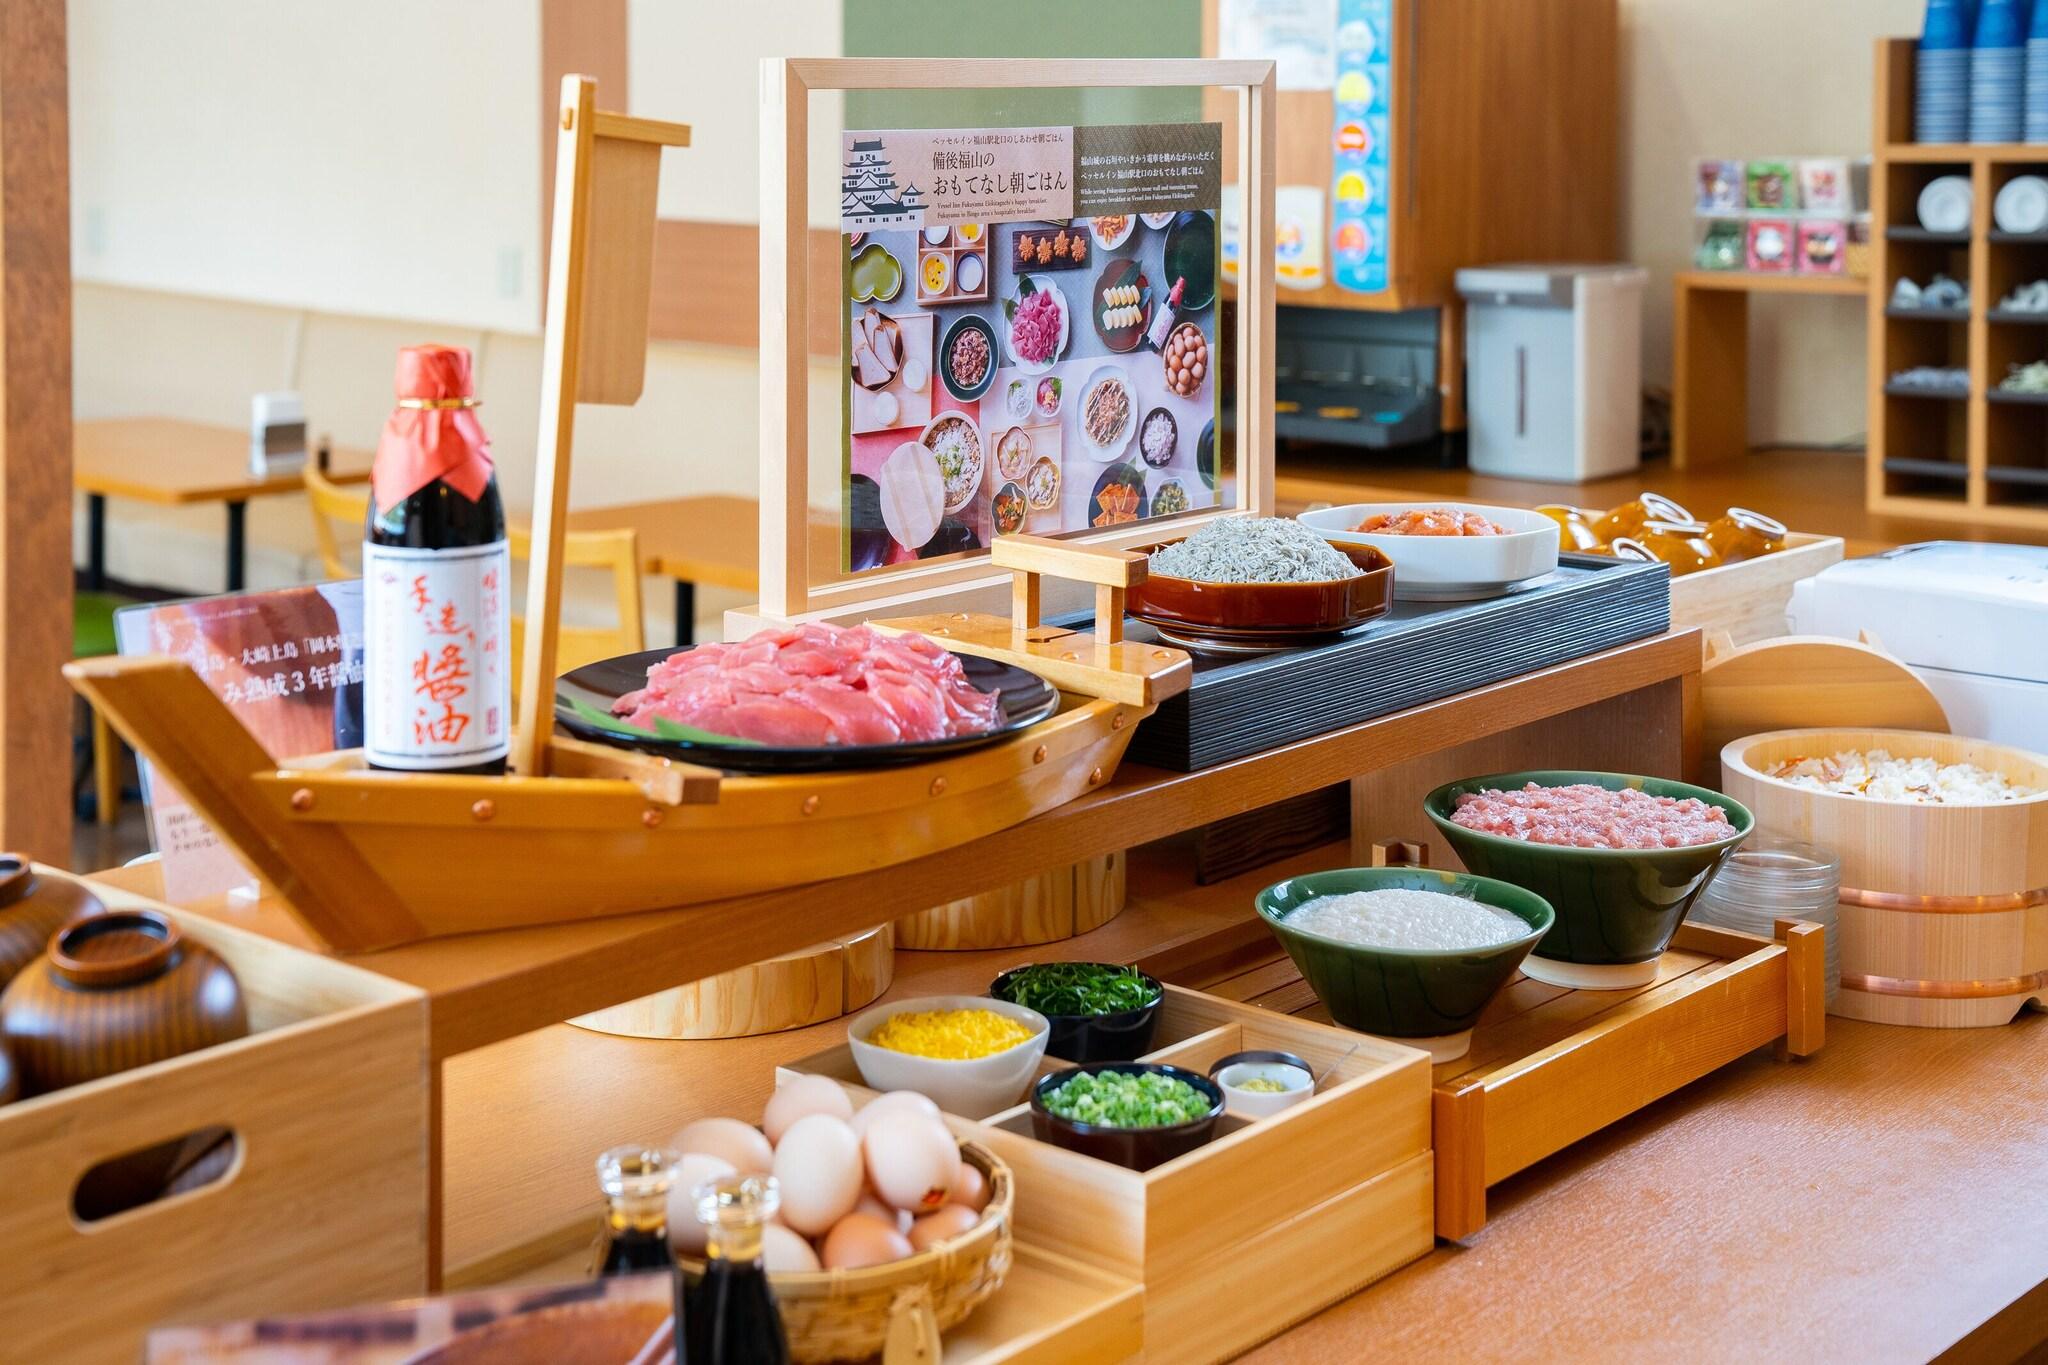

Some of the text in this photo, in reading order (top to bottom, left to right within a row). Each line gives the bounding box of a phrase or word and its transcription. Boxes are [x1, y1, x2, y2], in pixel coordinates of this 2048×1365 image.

[932, 151, 995, 170] 備後福山の
[933, 171, 1068, 196] おもてなし朝ごはん
